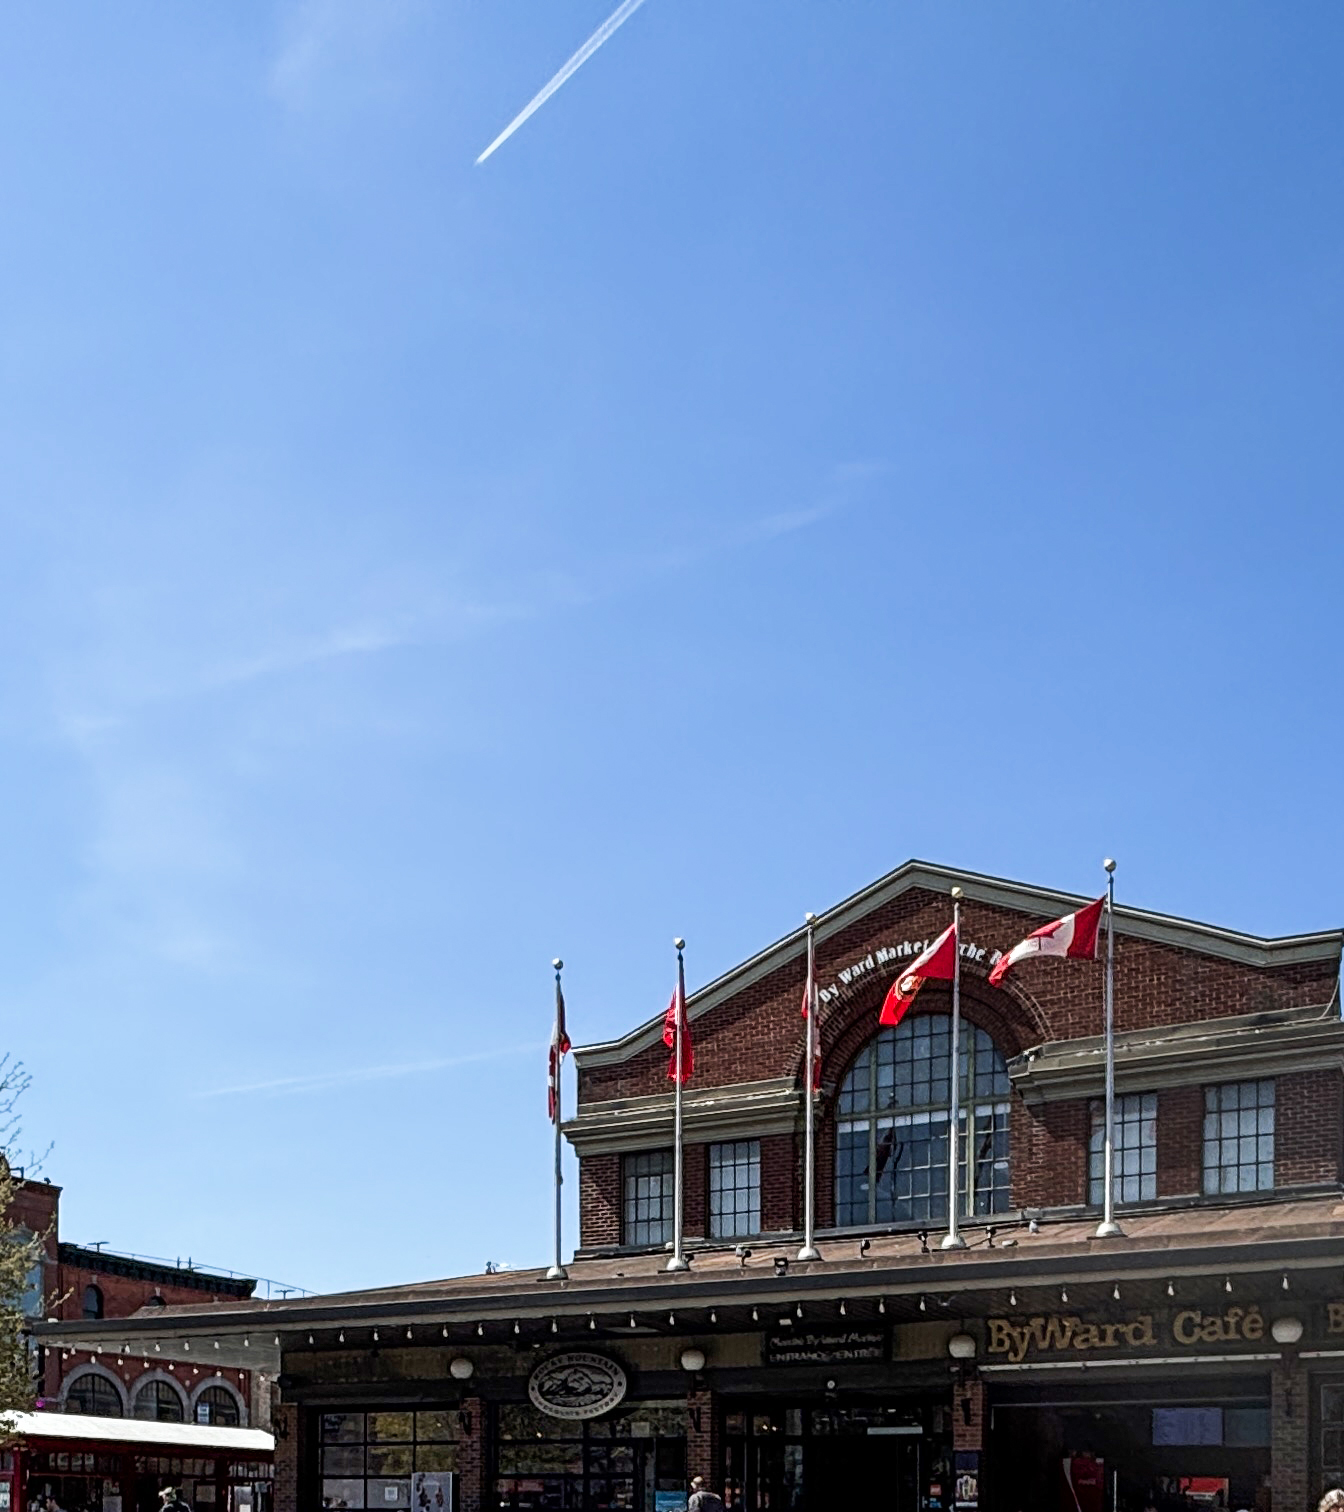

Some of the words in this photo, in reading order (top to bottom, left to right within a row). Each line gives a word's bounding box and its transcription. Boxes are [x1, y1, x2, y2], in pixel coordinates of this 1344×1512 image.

[819, 983, 839, 1004] By
[838, 954, 875, 986] Ward
[987, 1315, 1156, 1362] ByWard
[1172, 1306, 1264, 1344] Café
